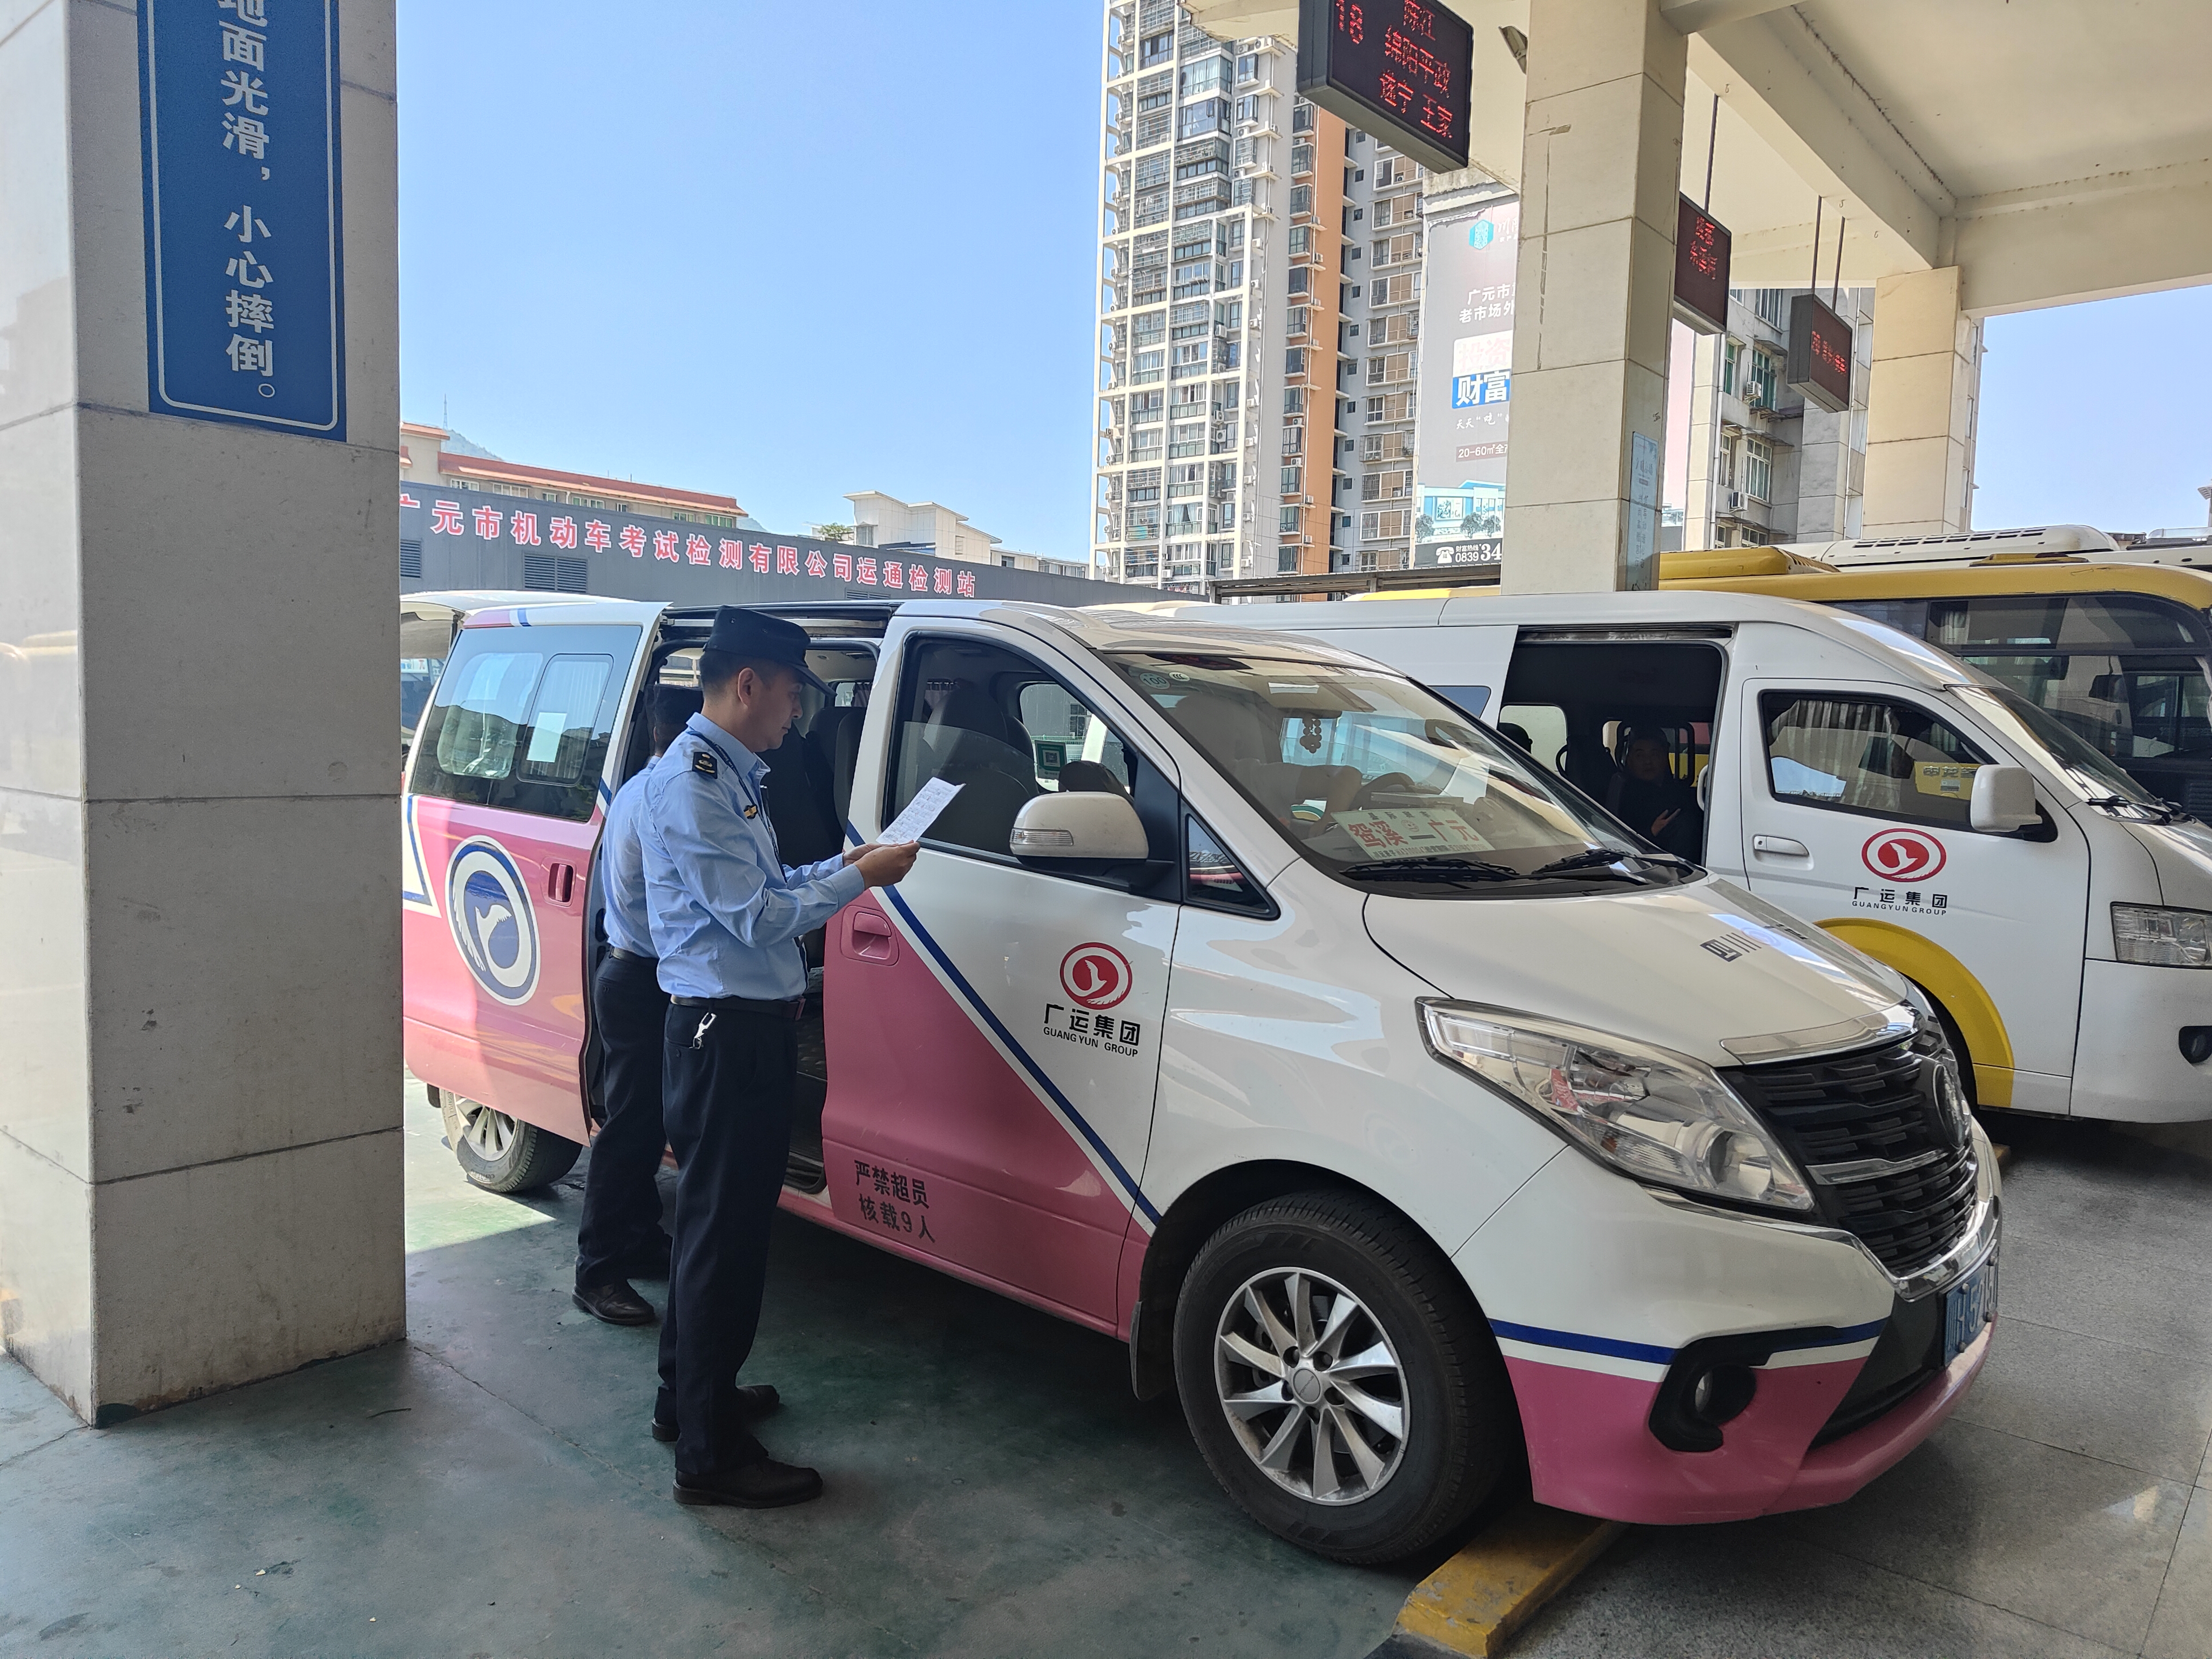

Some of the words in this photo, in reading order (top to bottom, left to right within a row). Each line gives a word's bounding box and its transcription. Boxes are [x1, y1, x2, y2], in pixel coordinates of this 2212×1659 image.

[1456, 370, 1510, 407] 财富
[1455, 551, 1479, 563] 0839
[1853, 887, 1947, 909] 广运集团
[1911, 906, 1947, 916] GROUP
[1044, 1003, 1141, 1046] 广运集团
[1104, 1042, 1138, 1058] GROUP
[854, 1159, 929, 1209] 严禁超员
[859, 1193, 936, 1244] 核载9人
